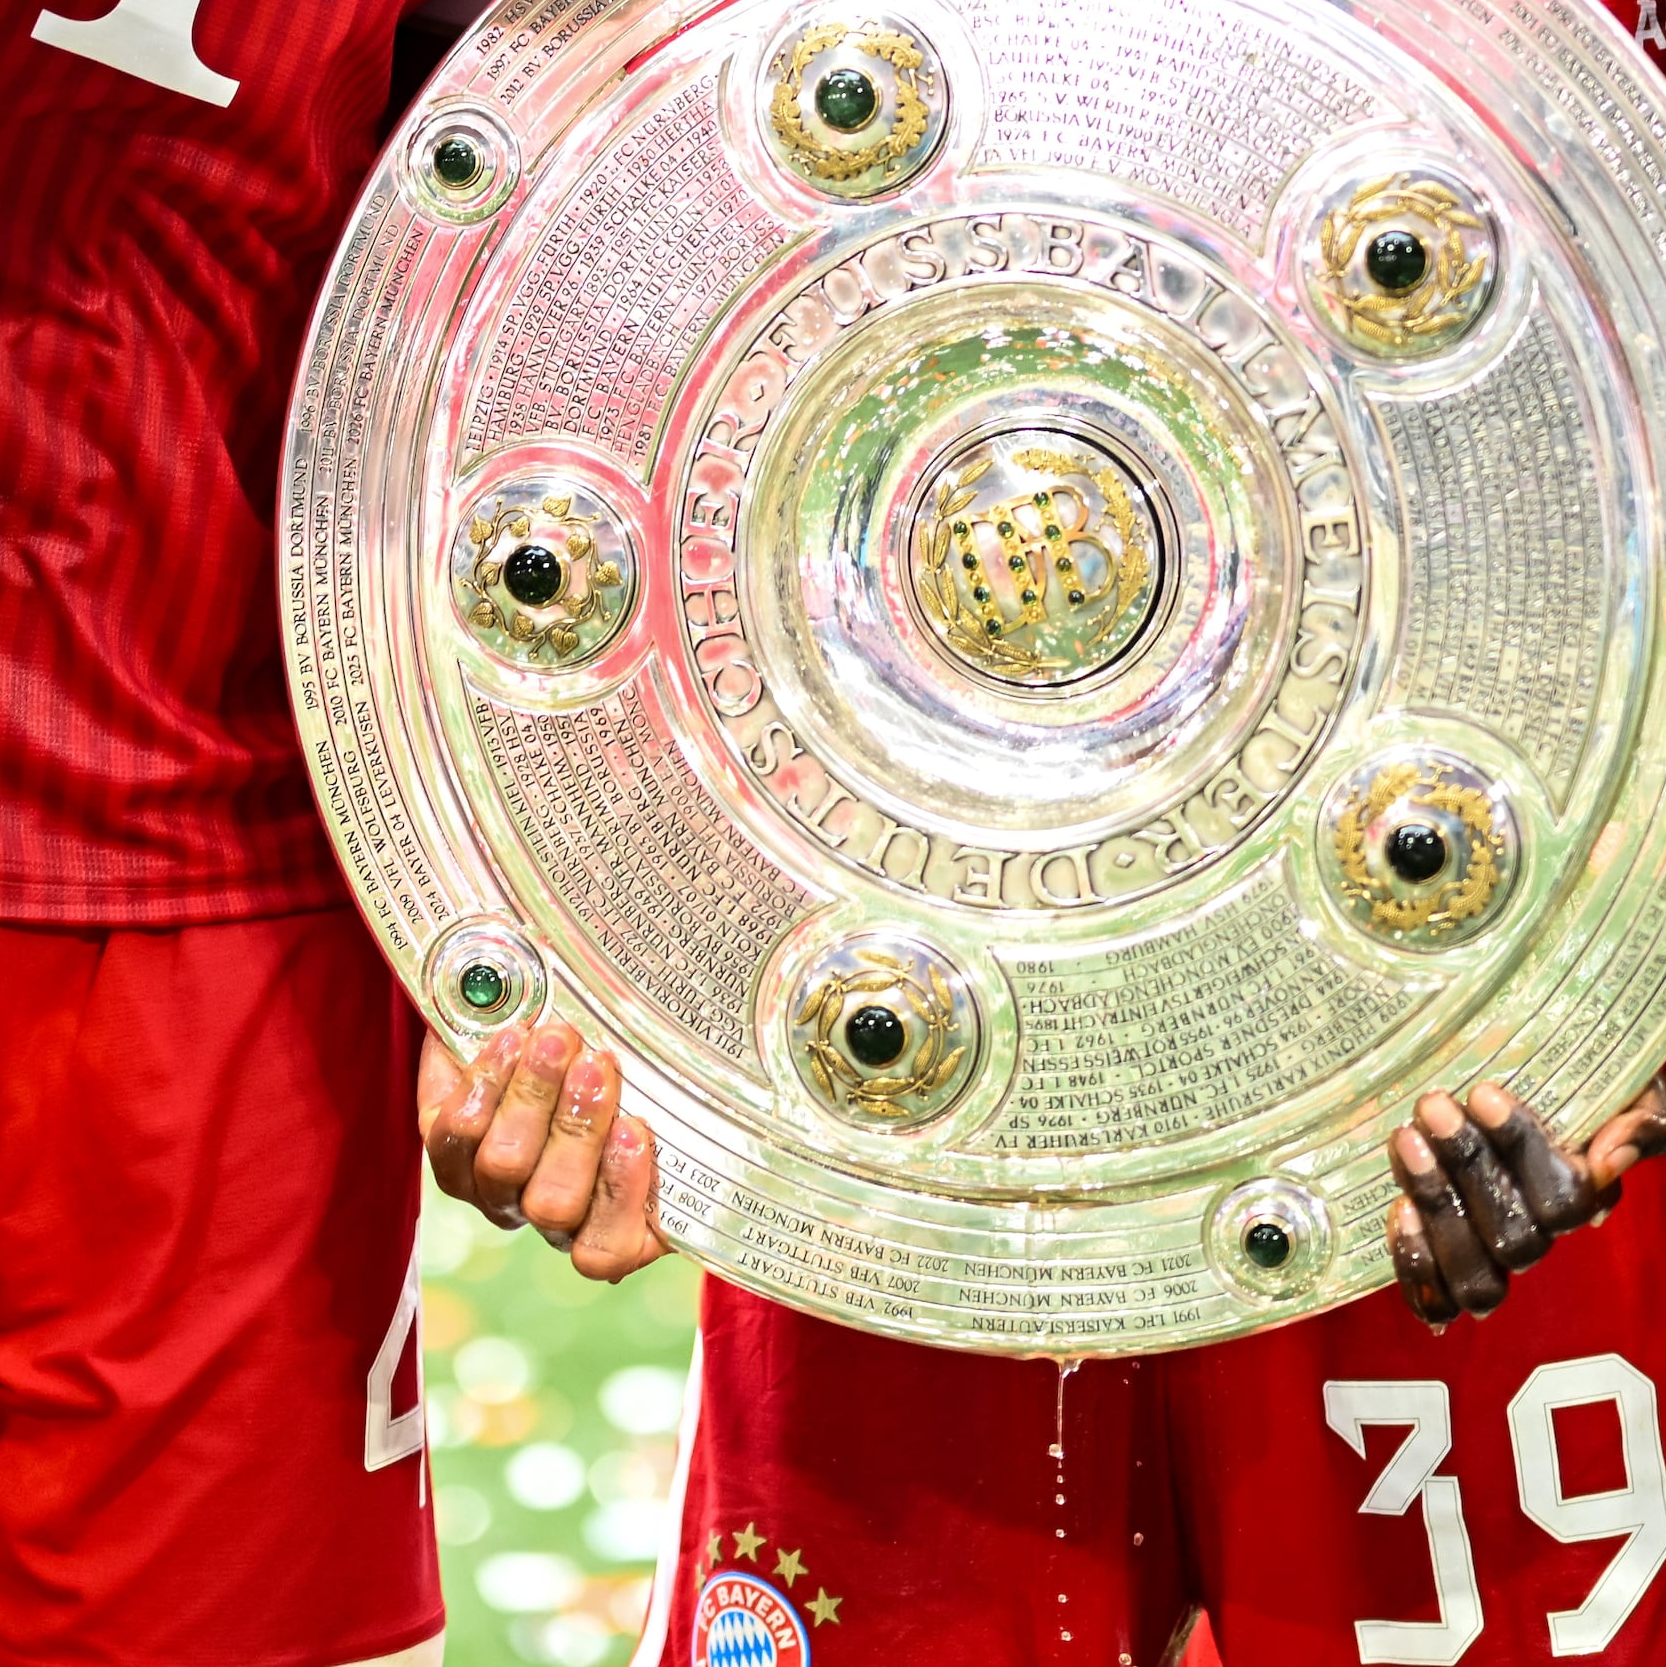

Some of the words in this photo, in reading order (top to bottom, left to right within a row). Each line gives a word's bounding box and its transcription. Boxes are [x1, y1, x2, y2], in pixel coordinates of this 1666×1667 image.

[475, 24, 506, 57] 1982
[485, 51, 514, 82] 1997
[509, 32, 531, 55] FC
[499, 76, 526, 106] 2012
[521, 54, 545, 79] BV
[656, 148, 681, 174] 04
[601, 165, 664, 237] SCHALKE
[377, 226, 424, 311] MÜNCHEN
[578, 234, 609, 271] 1939
[560, 277, 582, 300] 96
[359, 315, 390, 382] BAYERN
[518, 298, 570, 398] HANNOVER
[353, 385, 370, 407] FC
[346, 411, 364, 444] 2026
[508, 398, 531, 437] 1938
[291, 457, 311, 556] DORTMUND
[338, 457, 360, 544] MÜNCHEN
[314, 495, 332, 584] MÜNCHEN
[339, 552, 355, 619] BAYERN
[291, 564, 309, 644] BORUSSIA
[316, 592, 335, 660] BAYERN
[342, 625, 358, 647] FC
[296, 651, 313, 673] BV
[323, 666, 340, 689] FC
[345, 653, 363, 686] 2025
[685, 412, 1107, 910] DEUTSCHER
[300, 679, 319, 710] 1995
[328, 695, 347, 726] 2010
[519, 722, 538, 744] 04
[354, 699, 399, 808] LEVERKUSEN
[313, 739, 352, 825] MÜNCHEN
[502, 776, 529, 815] KIEL
[528, 745, 575, 827] SCHALKE
[342, 748, 390, 852] WOLFSBURG
[388, 811, 407, 831] 04
[343, 829, 380, 894] BAYERN
[397, 833, 432, 887] BAYER
[518, 811, 575, 897] HOLSTEIN
[568, 827, 596, 863] 1937
[380, 855, 405, 889] VFL
[371, 894, 392, 919] FC
[397, 891, 424, 925] 2009
[422, 888, 450, 922] 2024
[566, 890, 596, 924] 1912
[598, 871, 676, 962] NÜRNBERG
[384, 919, 409, 952] 1994
[1103, 921, 1198, 964] HAMBURG
[596, 927, 647, 983] BERLIN
[1016, 957, 1053, 975] 1980
[639, 972, 714, 1041] VIKTORIA
[708, 983, 744, 1016] 1936
[712, 1030, 745, 1061] 1911
[664, 1150, 688, 1173] FC
[688, 1165, 721, 1193] 2023
[677, 1189, 711, 1217] 2008
[730, 1188, 815, 1239] MÜNCHEN
[658, 1207, 690, 1234] 1993
[741, 1222, 844, 1275] STUTTGART
[819, 1227, 884, 1260] BAYERN
[888, 1247, 910, 1266] FC
[736, 1249, 838, 1300] STUTTGART
[848, 1263, 881, 1286] VFB
[915, 1253, 948, 1273] 2022
[963, 1261, 1051, 1283] MÜNCHEN
[1061, 1263, 1127, 1281] BAYERN
[1131, 1260, 1153, 1277] FC
[1160, 1253, 1192, 1272] 2021
[843, 1289, 876, 1311] VFB
[887, 1274, 920, 1294] 2007
[958, 1287, 1050, 1309] MÜNCHEN
[1060, 1289, 1126, 1307] BAYERN
[1132, 1286, 1155, 1303] FC
[1162, 1278, 1198, 1299] 2006
[882, 1299, 913, 1319] 1992
[971, 1315, 1125, 1334] KAISERSLAUTERN
[1171, 1304, 1201, 1324] 1991
[717, 1584, 797, 1649] BAYERN
